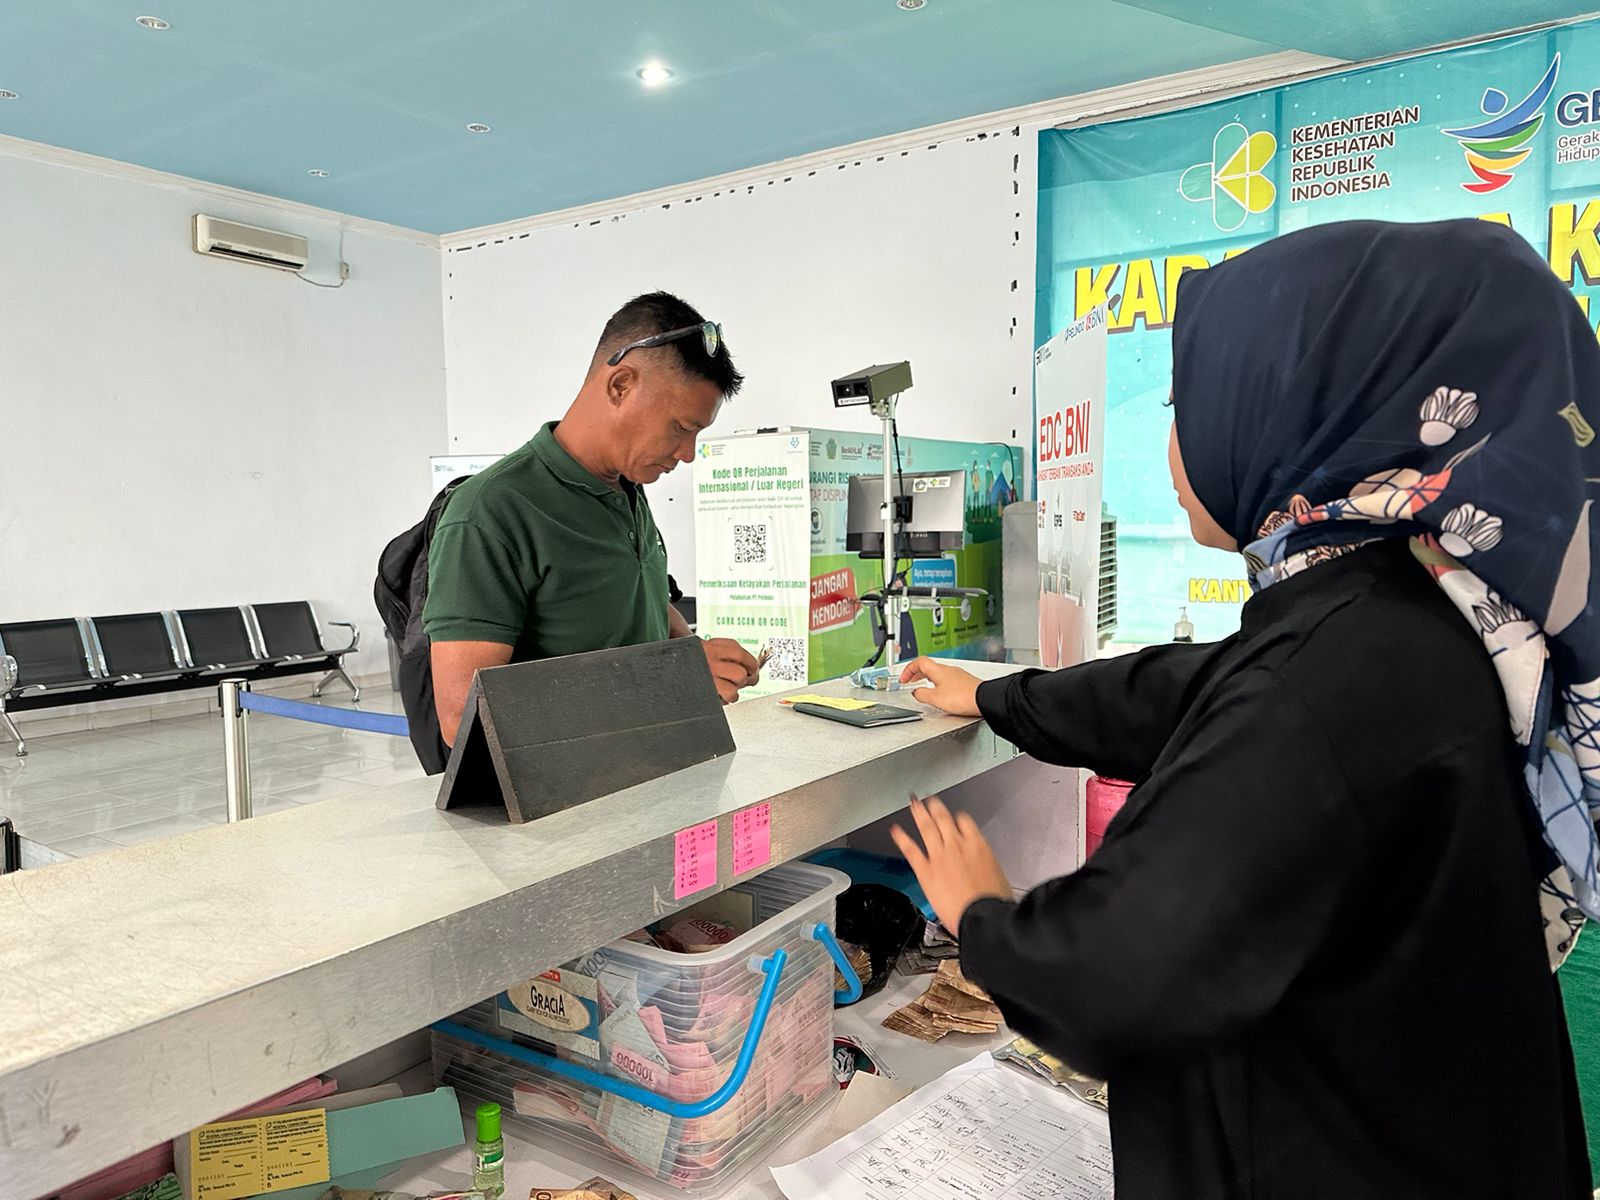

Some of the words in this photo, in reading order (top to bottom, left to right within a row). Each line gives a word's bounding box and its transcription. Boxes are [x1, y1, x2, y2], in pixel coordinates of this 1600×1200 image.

[1293, 107, 1418, 144] KEMENTERIAN
[1292, 132, 1394, 163] KESEHATAN
[1558, 147, 1600, 162] Hidup
[1292, 155, 1375, 182] REPUBLIK
[1292, 173, 1390, 202] INDONESIA
[1040, 411, 1062, 462] EDC
[1065, 400, 1091, 457] BNI
[713, 469, 731, 479] Kode
[745, 465, 787, 478] Perjalanan
[699, 481, 749, 494] Internasional
[757, 480, 774, 491] Luar
[776, 478, 804, 491] Negeri
[699, 579, 738, 589] Pemeriksaan
[739, 579, 770, 589] Kelayakan
[772, 580, 807, 590] Perjalanan
[812, 571, 848, 599] JANGAN
[717, 617, 735, 626] CARA
[738, 617, 755, 626] SCAN
[770, 617, 788, 628] CODE
[812, 596, 850, 628] KENDOR!
[691, 919, 729, 941] 00000
[530, 985, 566, 1017] GRACIA
